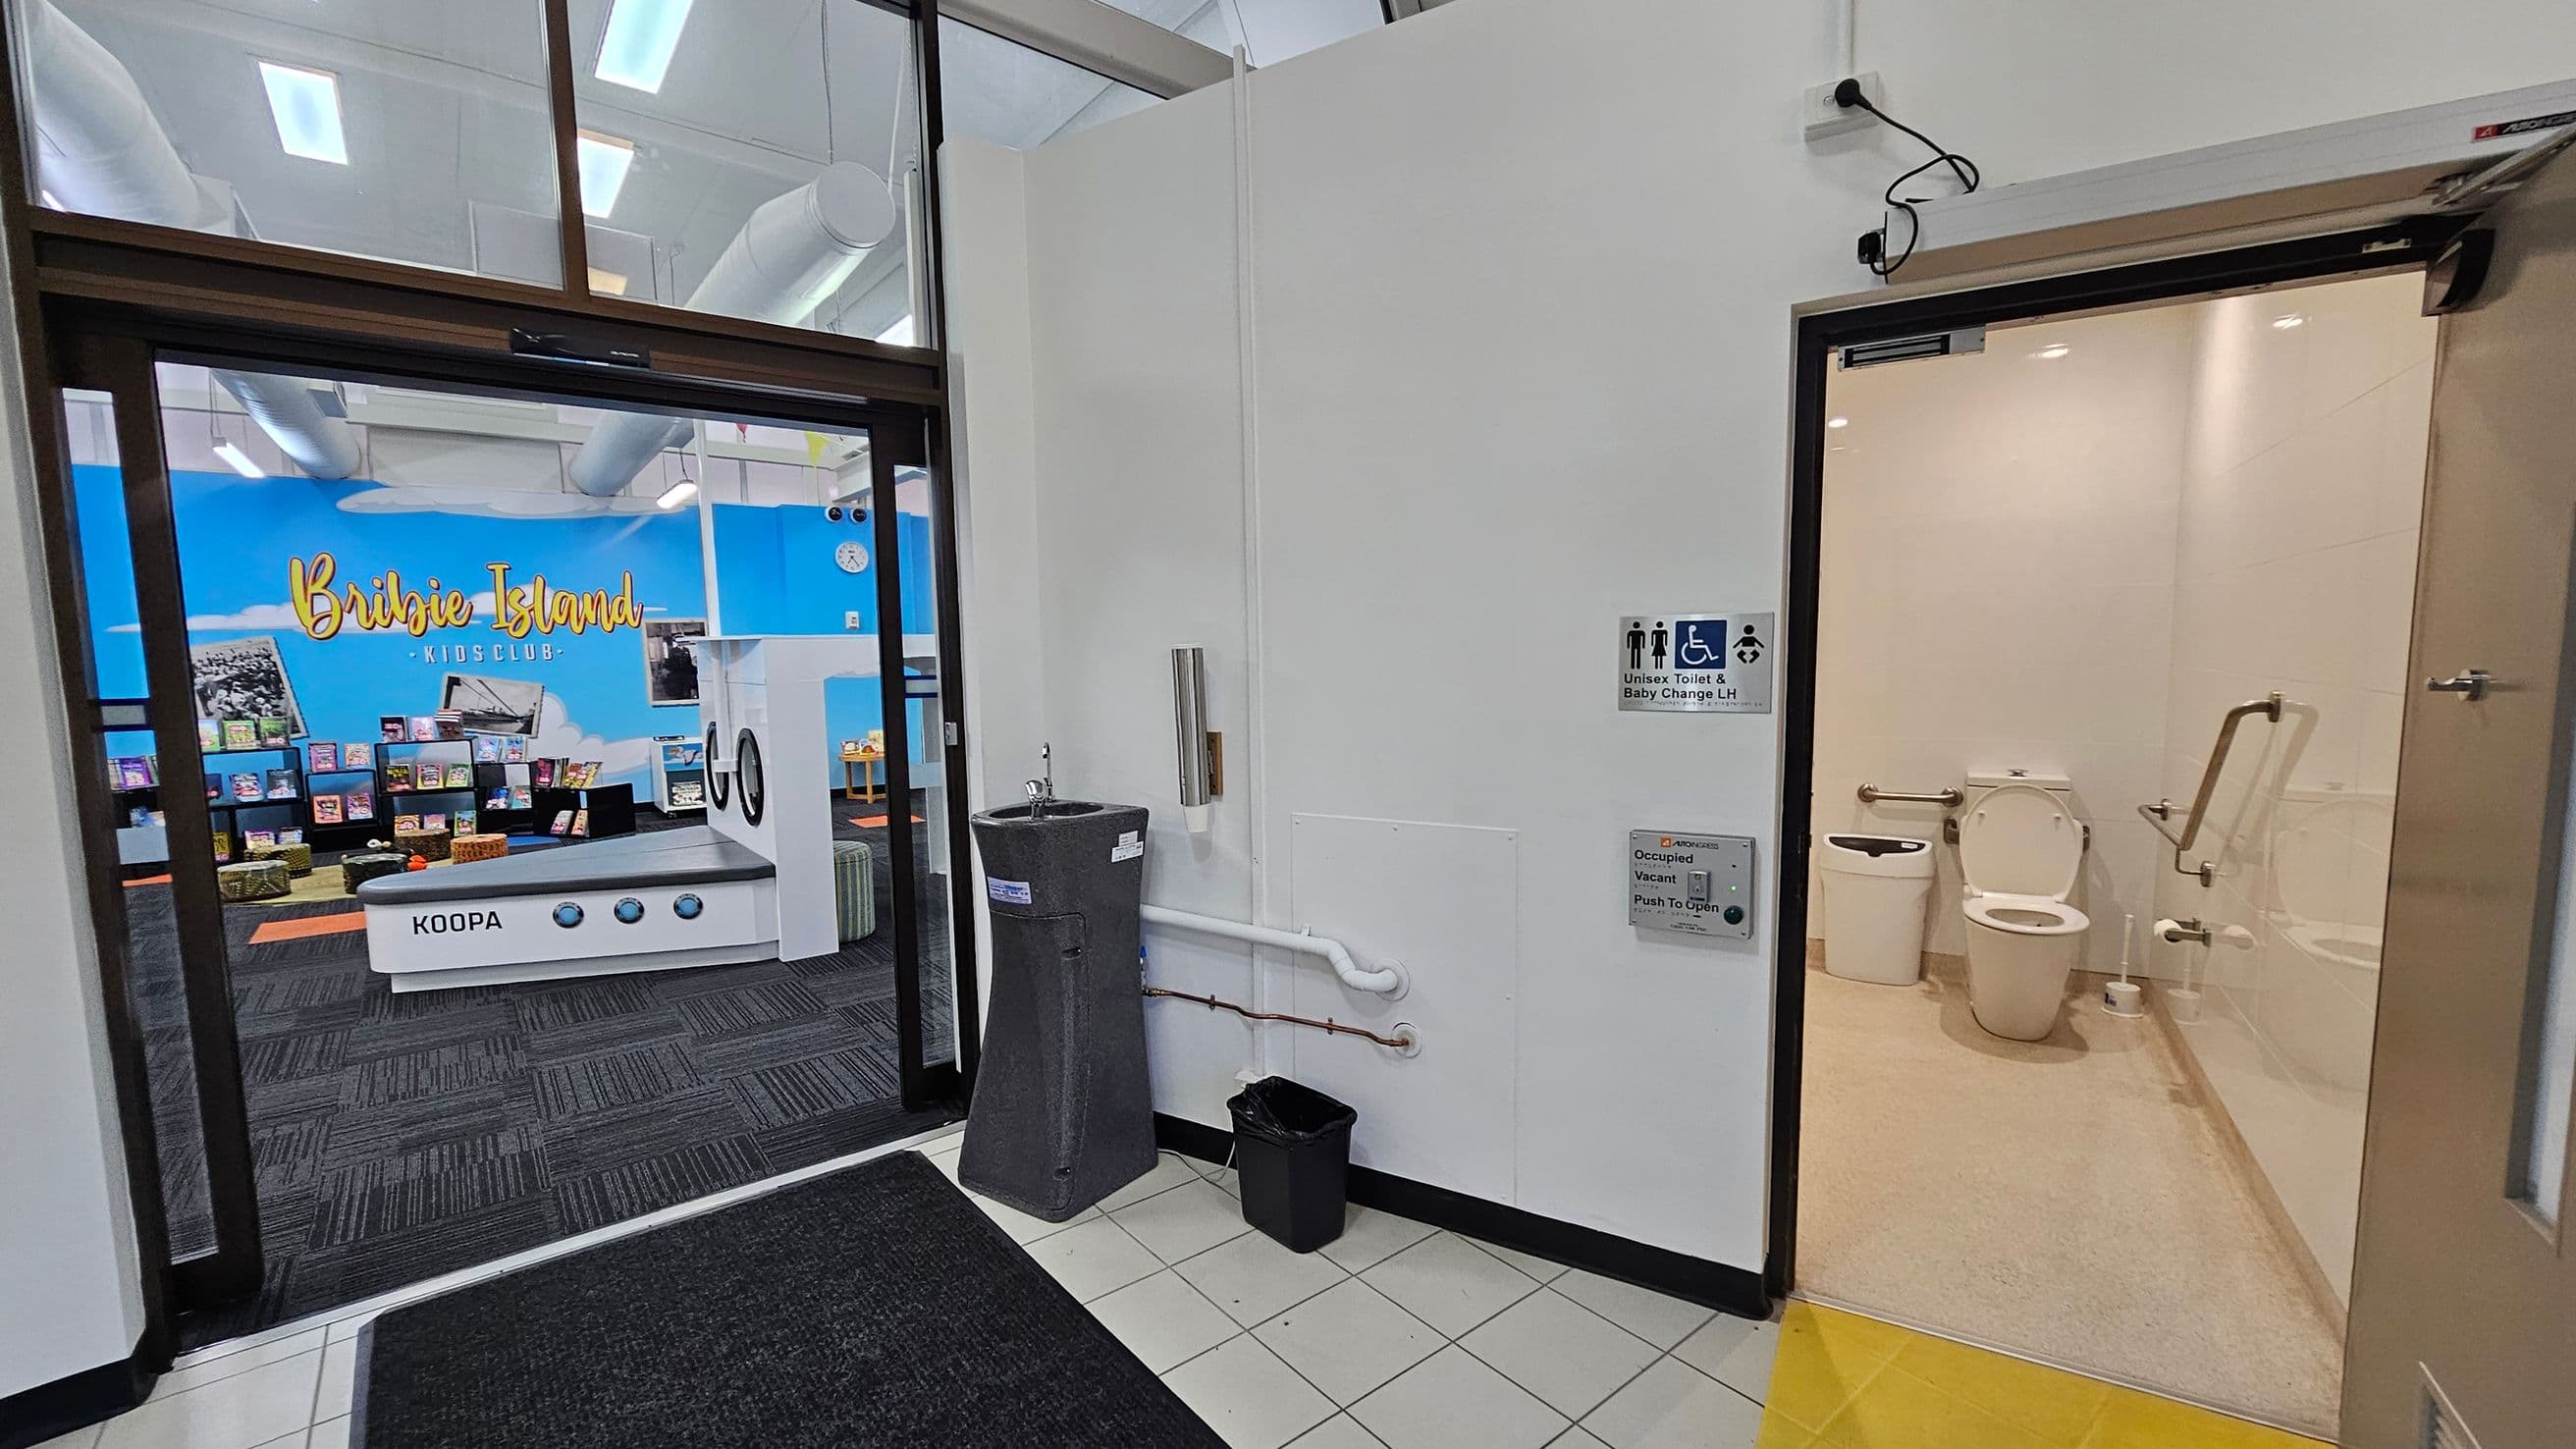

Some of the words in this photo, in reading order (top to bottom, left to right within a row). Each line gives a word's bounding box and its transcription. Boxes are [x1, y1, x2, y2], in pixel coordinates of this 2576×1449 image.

[290, 553, 473, 640] Bribie
[486, 563, 643, 639] Island
[425, 645, 485, 664] KIDS
[495, 644, 554, 662] CLUB
[1624, 673, 1669, 684] Unisex
[1674, 673, 1711, 684] Toilet
[1716, 673, 1727, 684] &
[1624, 688, 1657, 701] Baby
[1662, 688, 1713, 701] Change
[1718, 688, 1737, 699] LH
[1635, 849, 1693, 864] Occupied
[1635, 871, 1677, 885] Vacant
[1635, 894, 1665, 907] Push
[1668, 897, 1683, 909] To
[1685, 900, 1719, 913] Open
[412, 911, 503, 935] KOOPA
